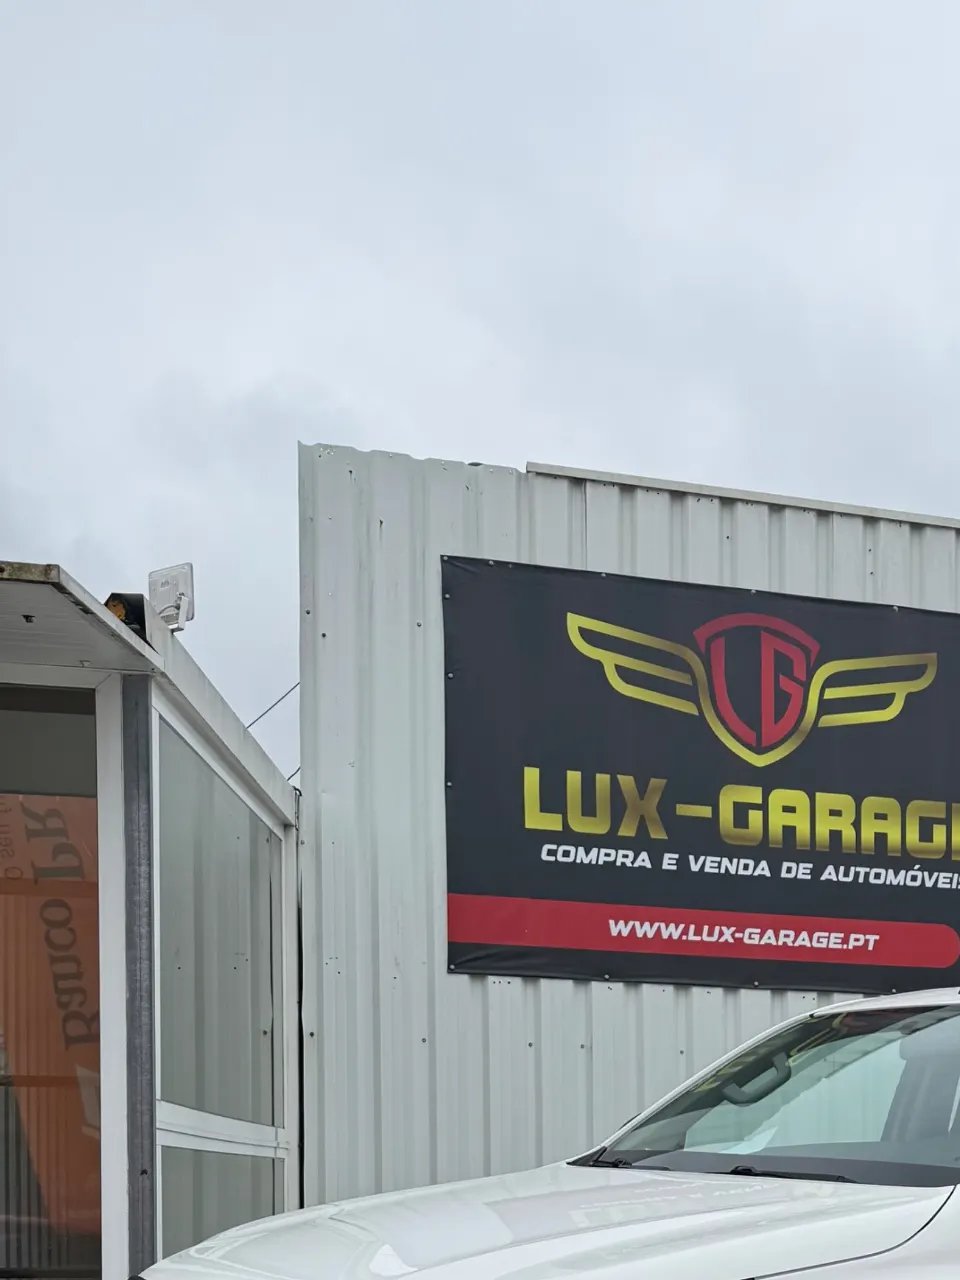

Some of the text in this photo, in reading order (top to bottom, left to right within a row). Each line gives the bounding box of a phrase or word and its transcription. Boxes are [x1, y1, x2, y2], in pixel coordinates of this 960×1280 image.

[540, 843, 652, 870] COMPRA
[661, 852, 680, 871] E
[688, 854, 772, 879] VENDA
[780, 861, 813, 880] DE
[607, 918, 880, 952] WWW.LUX-GARAGE.PT
